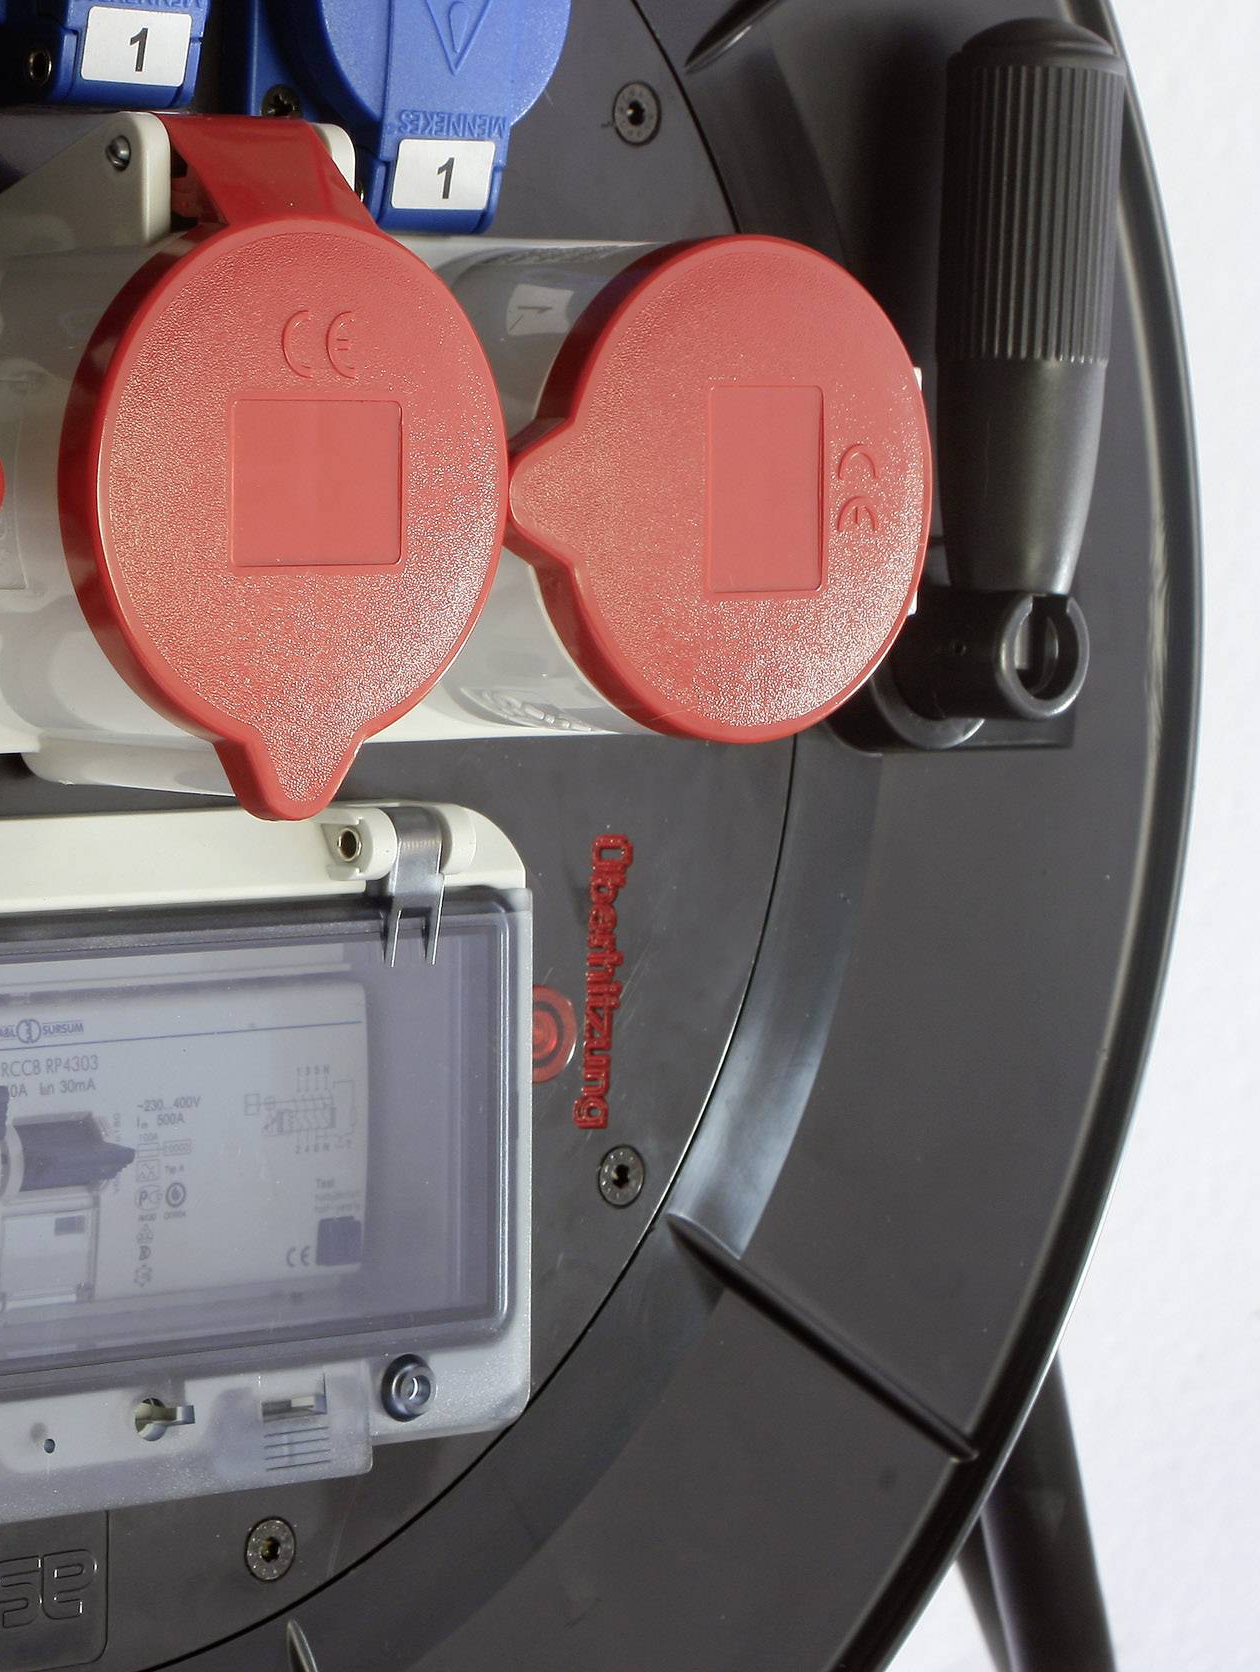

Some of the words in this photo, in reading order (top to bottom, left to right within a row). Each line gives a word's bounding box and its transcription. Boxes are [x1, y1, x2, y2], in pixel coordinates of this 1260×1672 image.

[129, 27, 149, 73] 1
[398, 108, 507, 138] MENNEKES
[436, 156, 455, 200] 1
